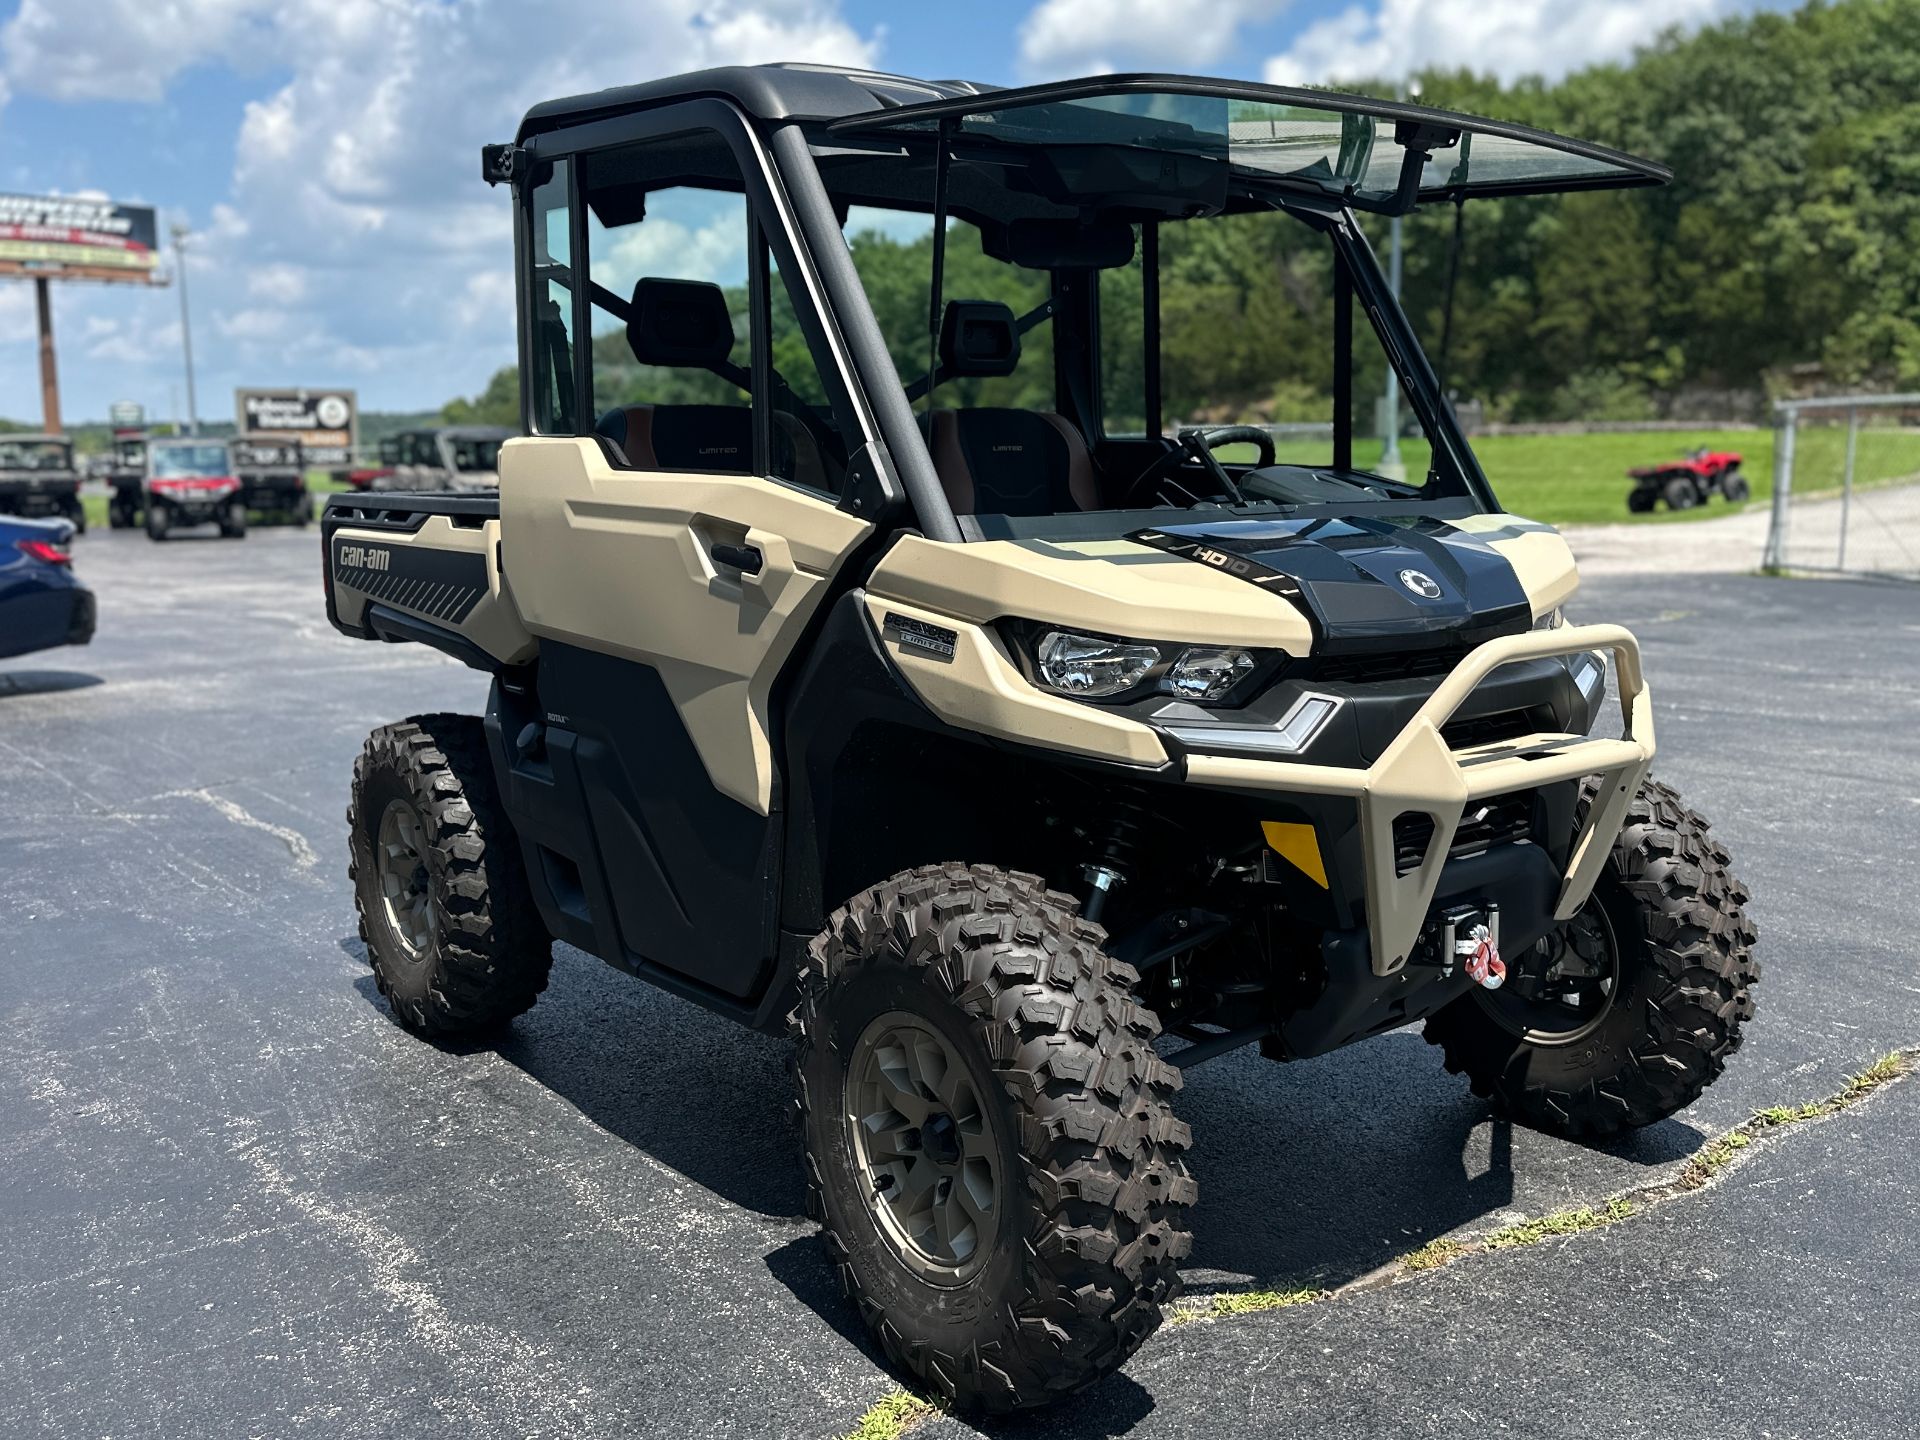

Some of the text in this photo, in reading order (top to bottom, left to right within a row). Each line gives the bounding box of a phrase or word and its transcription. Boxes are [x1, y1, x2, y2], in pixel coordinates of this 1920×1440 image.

[699, 447, 738, 455] LIMITED
[340, 545, 390, 571] can-am
[1192, 546, 1250, 574] HD10
[886, 614, 958, 645] DEFENDER
[902, 633, 952, 653] LIMITED
